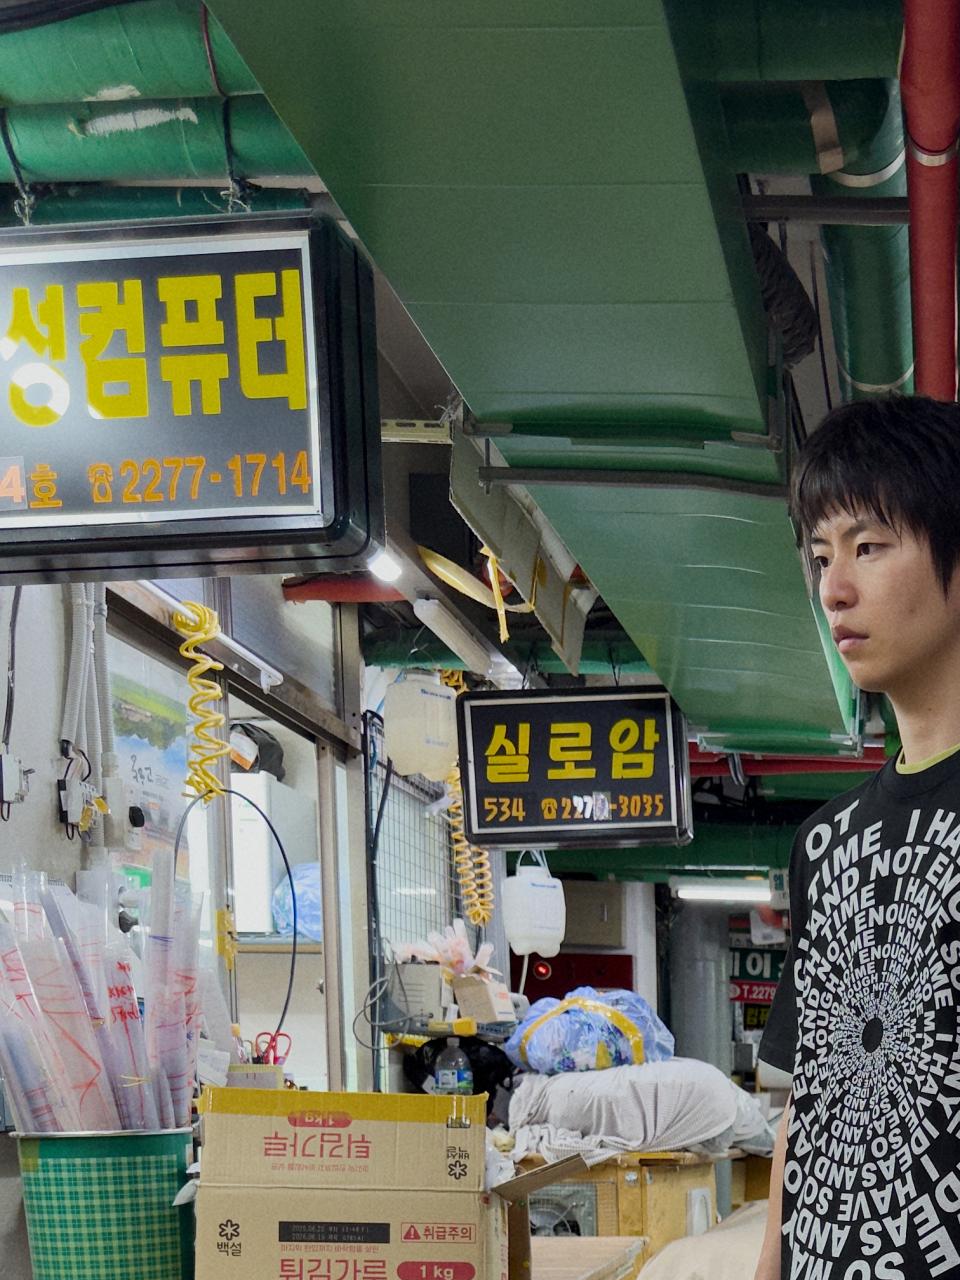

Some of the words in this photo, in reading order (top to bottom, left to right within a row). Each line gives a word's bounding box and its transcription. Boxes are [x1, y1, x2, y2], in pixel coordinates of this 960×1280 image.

[118, 450, 312, 505] 2277-1714
[484, 717, 660, 784] 실로암
[484, 796, 526, 822] 534
[905, 808, 921, 843] I
[807, 821, 882, 904] TIME
[869, 845, 930, 881] NOT
[811, 867, 860, 940] AND
[893, 877, 904, 902] I
[904, 876, 951, 936] HAVE
[820, 883, 876, 942] TIME
[854, 903, 927, 940] ENOUGH
[816, 924, 848, 982] NOT
[924, 933, 954, 1010] TIME
[919, 966, 933, 1002] SO
[802, 988, 820, 1050] AND
[935, 1033, 954, 1042] I
[914, 1010, 936, 1090] MANY
[905, 1052, 949, 1133] HAVE
[263, 1130, 372, 1159] 튀김가루
[446, 1145, 470, 1159] 백설
[815, 1131, 867, 1165] MANY
[861, 1118, 939, 1187] IDEAS
[871, 1127, 903, 1158] SO
[814, 1158, 858, 1191] AND
[920, 1153, 940, 1182] I
[802, 1176, 833, 1213] SO
[837, 1170, 917, 1221] HAVE
[216, 1241, 243, 1258] 백설
[422, 1225, 473, 1242] 취급주의
[796, 1208, 851, 1257] AND
[419, 1264, 428, 1279] 1
[433, 1264, 455, 1280] kg
